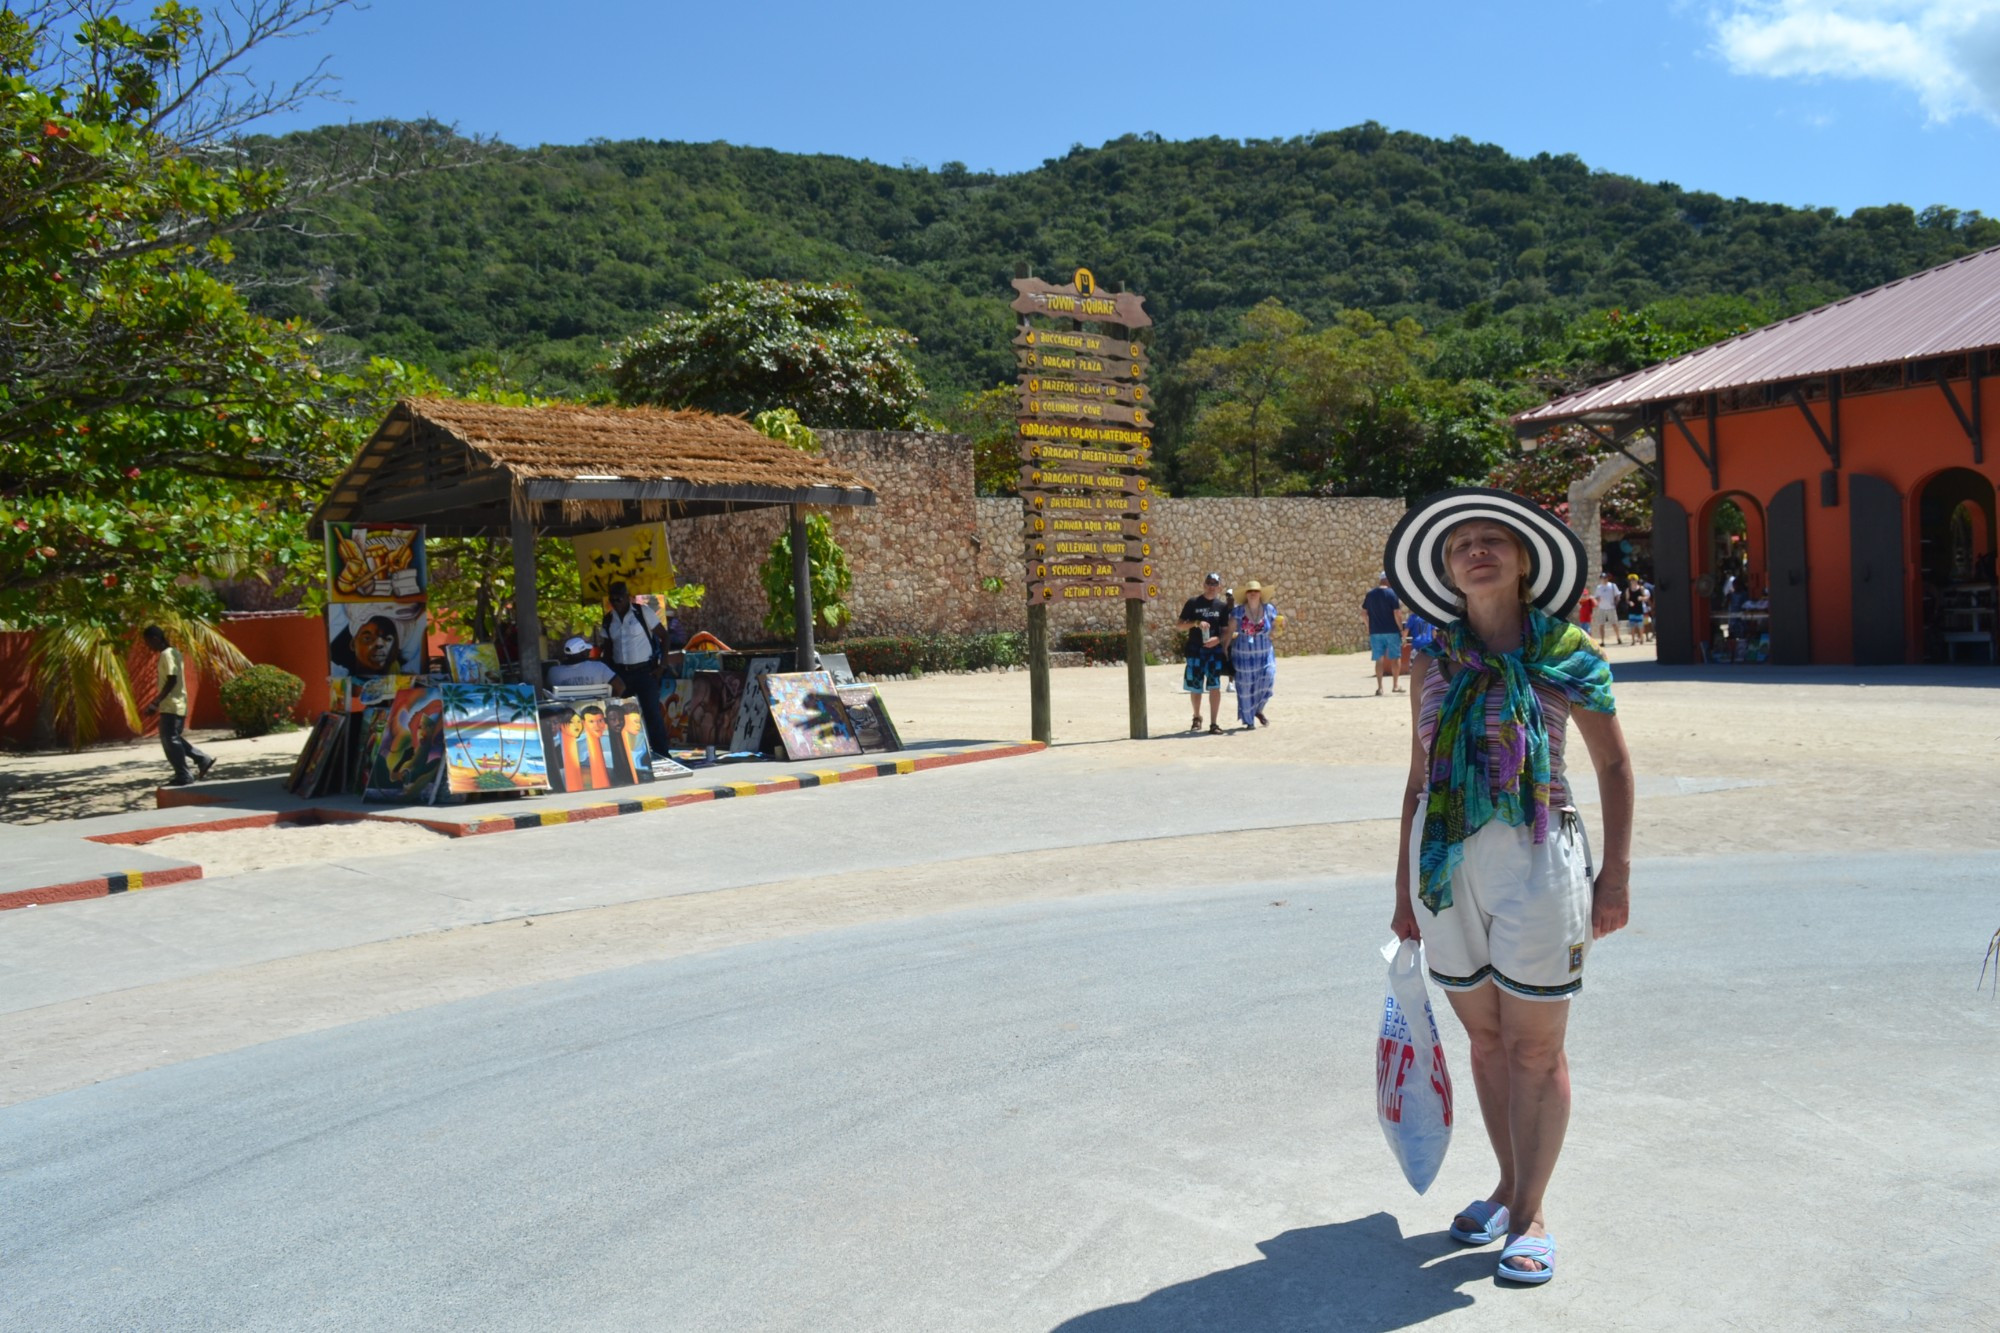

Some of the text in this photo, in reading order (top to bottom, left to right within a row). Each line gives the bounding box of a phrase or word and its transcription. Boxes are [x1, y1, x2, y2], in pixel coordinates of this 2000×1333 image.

[1046, 294, 1115, 315] TOWN SQUARE
[1086, 338, 1100, 349] BAY
[1042, 355, 1102, 372] DRAGON'S PLAZA
[1042, 379, 1078, 393] BAREFOOT
[1042, 402, 1101, 416] COLUMBUS COVE
[1027, 423, 1142, 443] DRAGON'S SPLASH WATERSLIDE
[1042, 446, 1079, 459] DRAGON'S
[1081, 449, 1106, 462] BREATH
[1042, 471, 1124, 487] DRAGON'S TAIL COASTER
[1050, 497, 1092, 509] BASKETBALL
[1105, 499, 1128, 509] SOCCER
[1053, 520, 1121, 532] ARAWAK AQUA PARK
[1056, 542, 1126, 553] VOLLEYBALL COURTS
[1051, 564, 1112, 576] SCHOONER BAR
[1064, 586, 1120, 598] RETURN TO PIER
